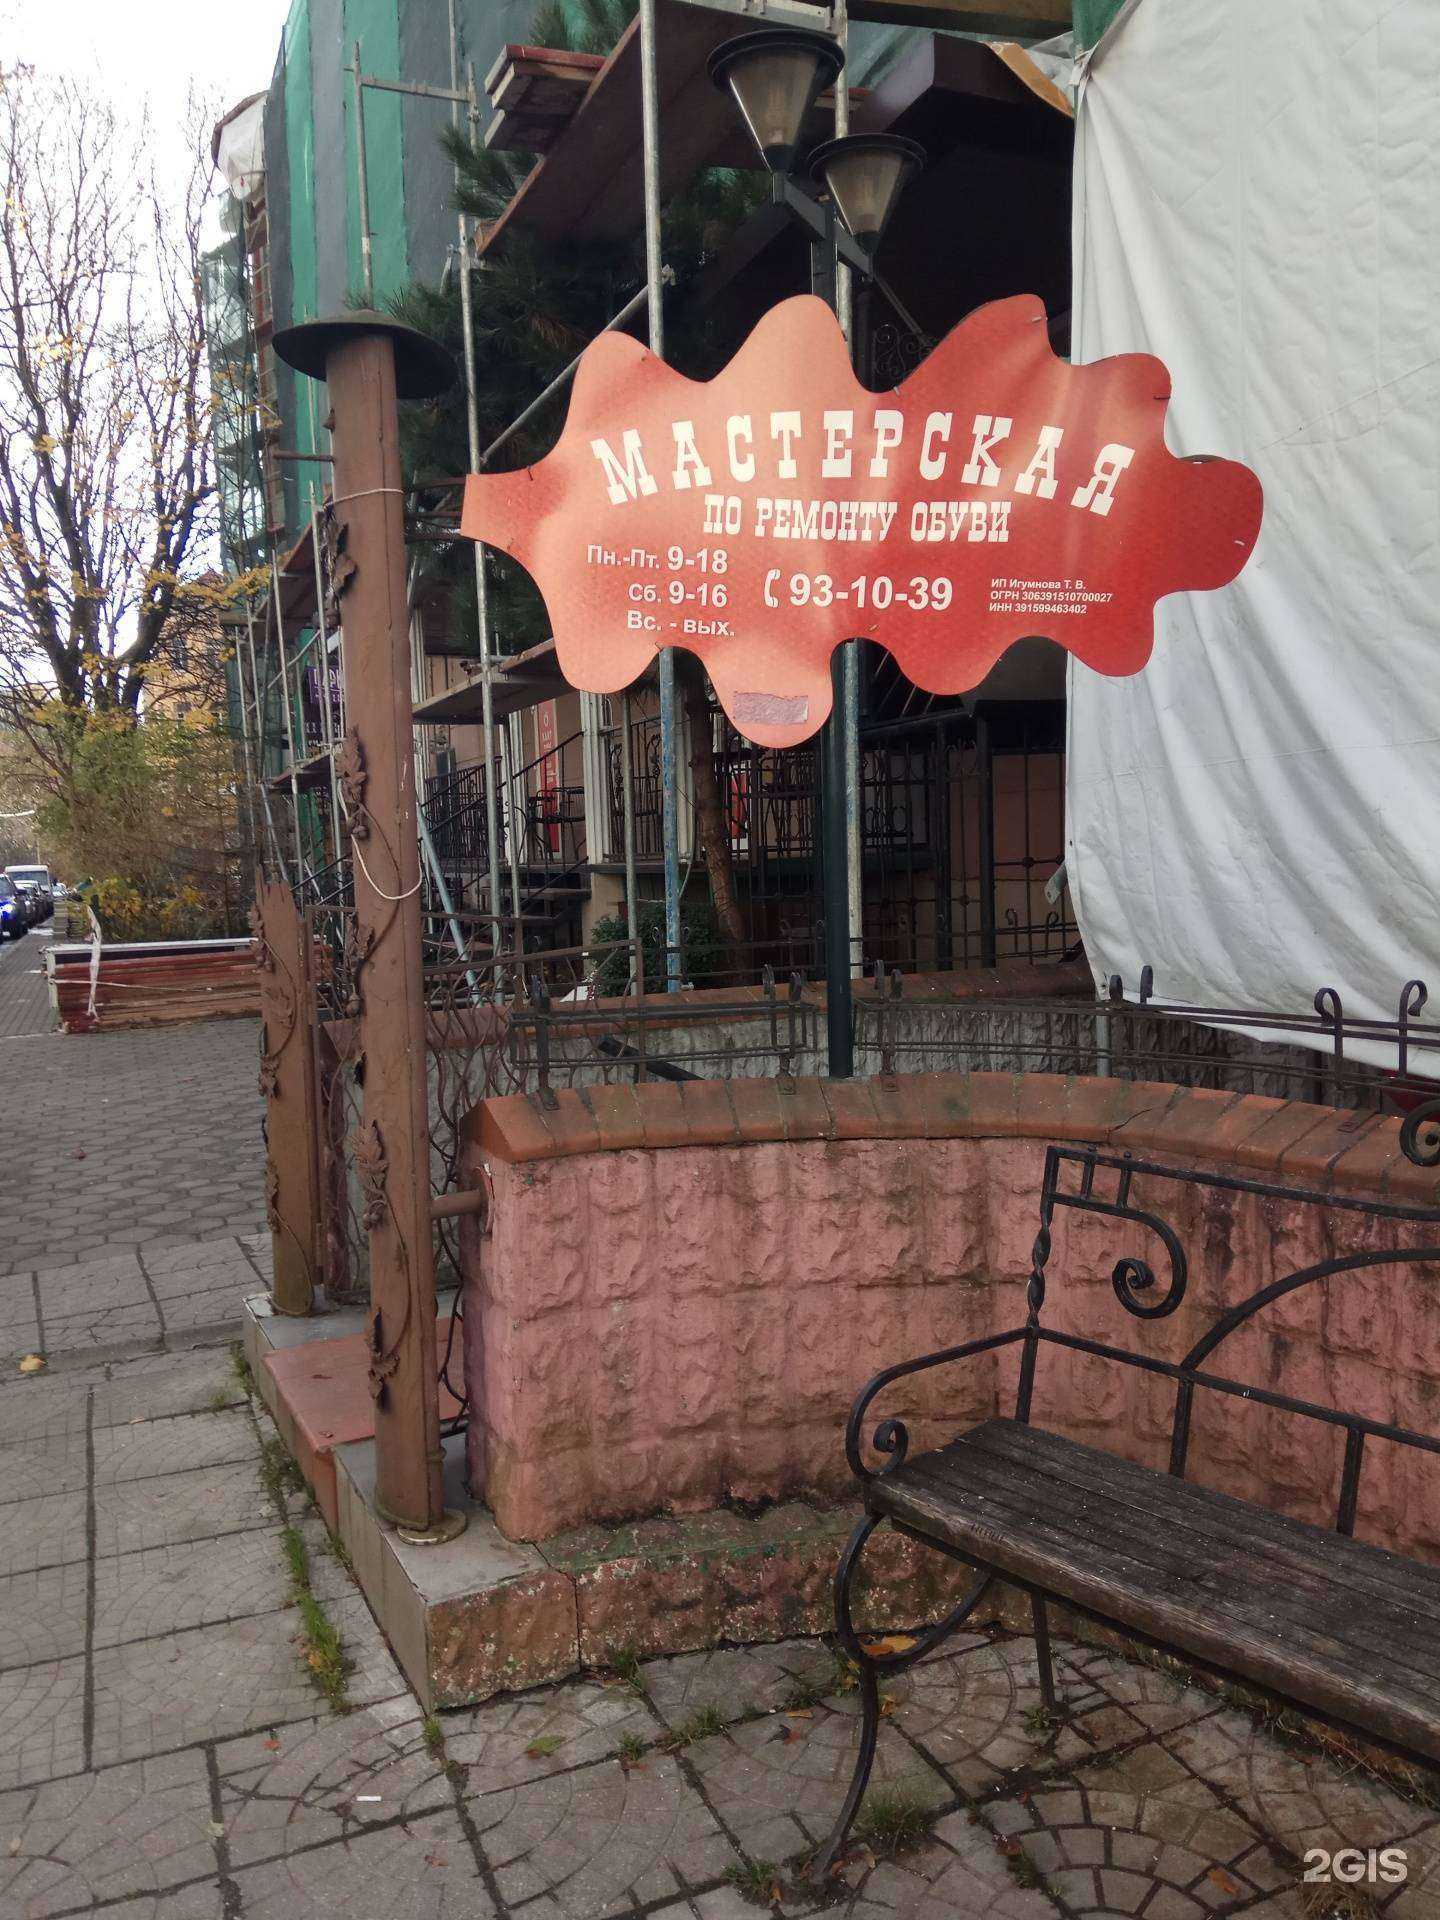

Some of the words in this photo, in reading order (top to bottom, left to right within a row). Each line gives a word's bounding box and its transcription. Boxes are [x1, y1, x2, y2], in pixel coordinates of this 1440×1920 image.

[590, 409, 1135, 517] МАСТЕРСКАЯ
[703, 494, 742, 535] ПО
[755, 497, 898, 542] РЕМОНТУ
[910, 500, 1012, 543] ОБУВИ
[587, 544, 660, 569] Пн.-Пт.
[667, 545, 728, 574] 9-18
[628, 583, 662, 603] Сб.
[668, 580, 728, 608] 9-16
[789, 573, 953, 611] 93-10-39
[990, 591, 1019, 600] ОГРН
[1022, 591, 1113, 602] 306391510700027
[991, 579, 1006, 588] ИП
[1009, 579, 1061, 590] Игумнова
[1064, 580, 1072, 589] Т.
[1075, 580, 1086, 589] В.
[989, 603, 1012, 612] ИНН
[1015, 603, 1087, 613] 391599463402
[627, 609, 662, 631] Вс.
[683, 619, 735, 637] вых.
